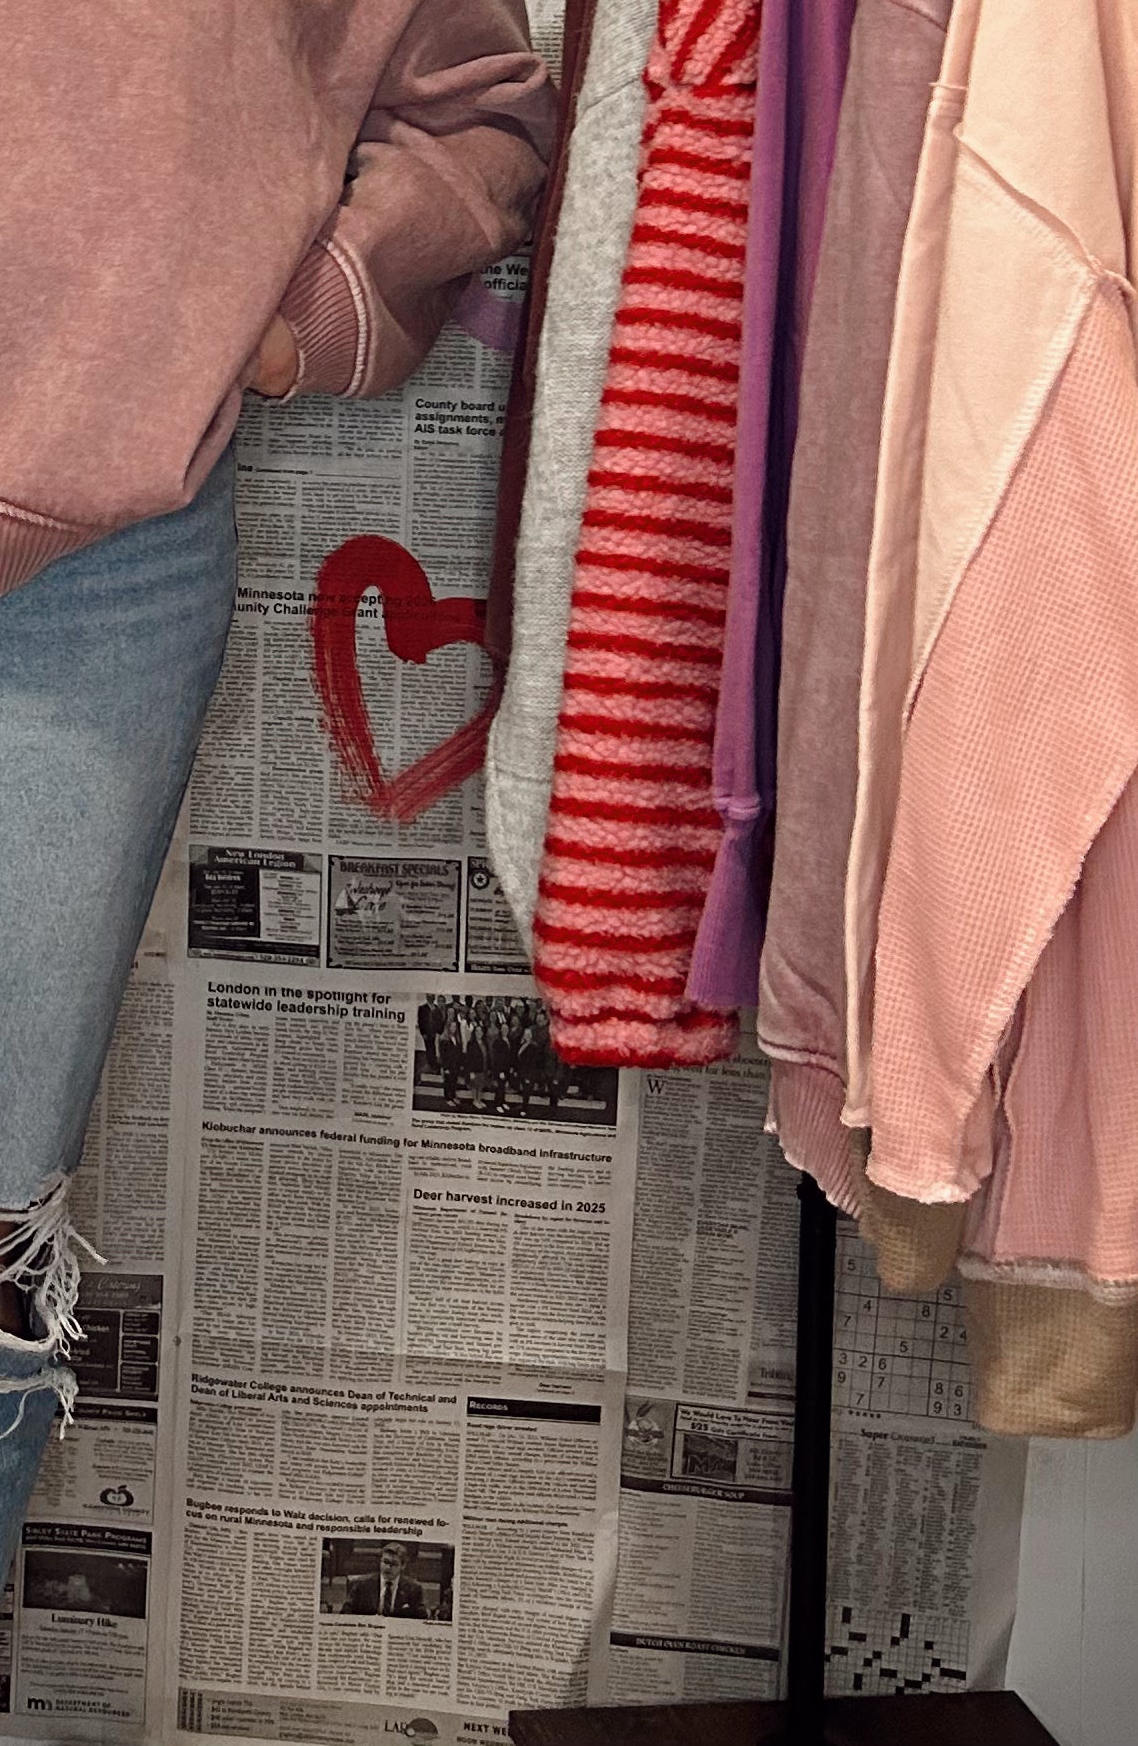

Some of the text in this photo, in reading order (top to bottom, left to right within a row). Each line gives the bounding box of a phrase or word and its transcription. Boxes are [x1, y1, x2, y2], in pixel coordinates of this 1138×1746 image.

[414, 398, 495, 412] County board
[414, 411, 491, 425] assignments,
[413, 423, 496, 436] AIS task force
[236, 586, 304, 601] Minnesota
[207, 981, 260, 996] London
[264, 985, 277, 997] in
[371, 991, 392, 1004] for
[206, 996, 405, 1023] statewide leadership training
[201, 1120, 612, 1162] Klobuchar announces federal funding for Minnesota broadband infrastructure
[412, 1187, 606, 1213] Deer harvest increased in 2025
